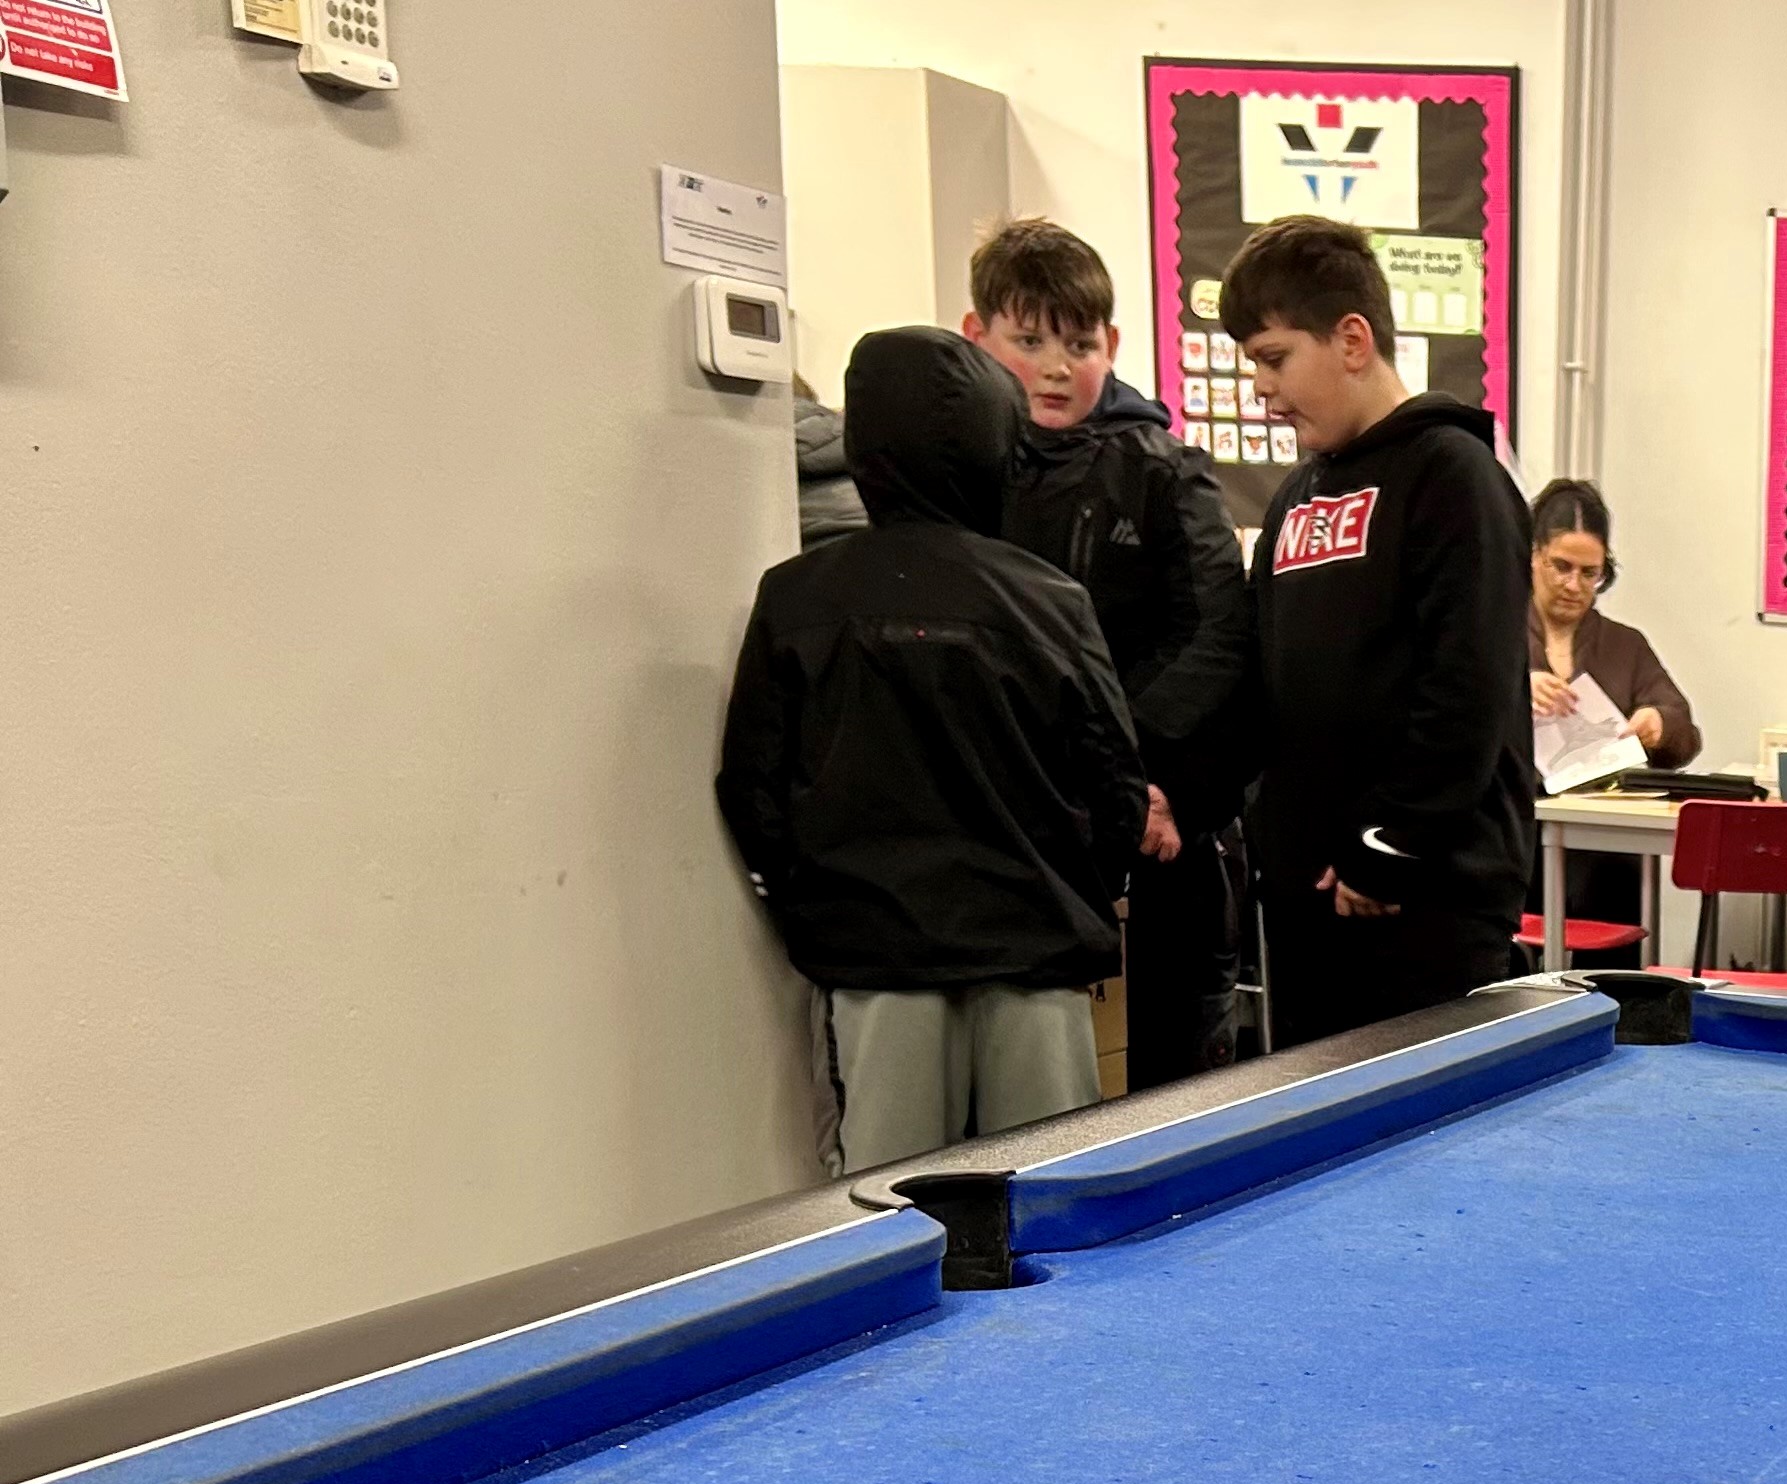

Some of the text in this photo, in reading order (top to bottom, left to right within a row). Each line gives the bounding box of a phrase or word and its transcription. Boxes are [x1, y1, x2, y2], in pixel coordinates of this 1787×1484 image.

[12, 2, 26, 13] not
[52, 11, 61, 22] to
[62, 14, 75, 26] the
[10, 41, 23, 54] Do
[24, 46, 39, 58] not
[39, 49, 58, 63] take
[58, 56, 73, 69] any
[1389, 247, 1421, 259] What
[1424, 251, 1442, 261] are
[1389, 261, 1419, 275] doing
[1278, 499, 1366, 563] NIKE
